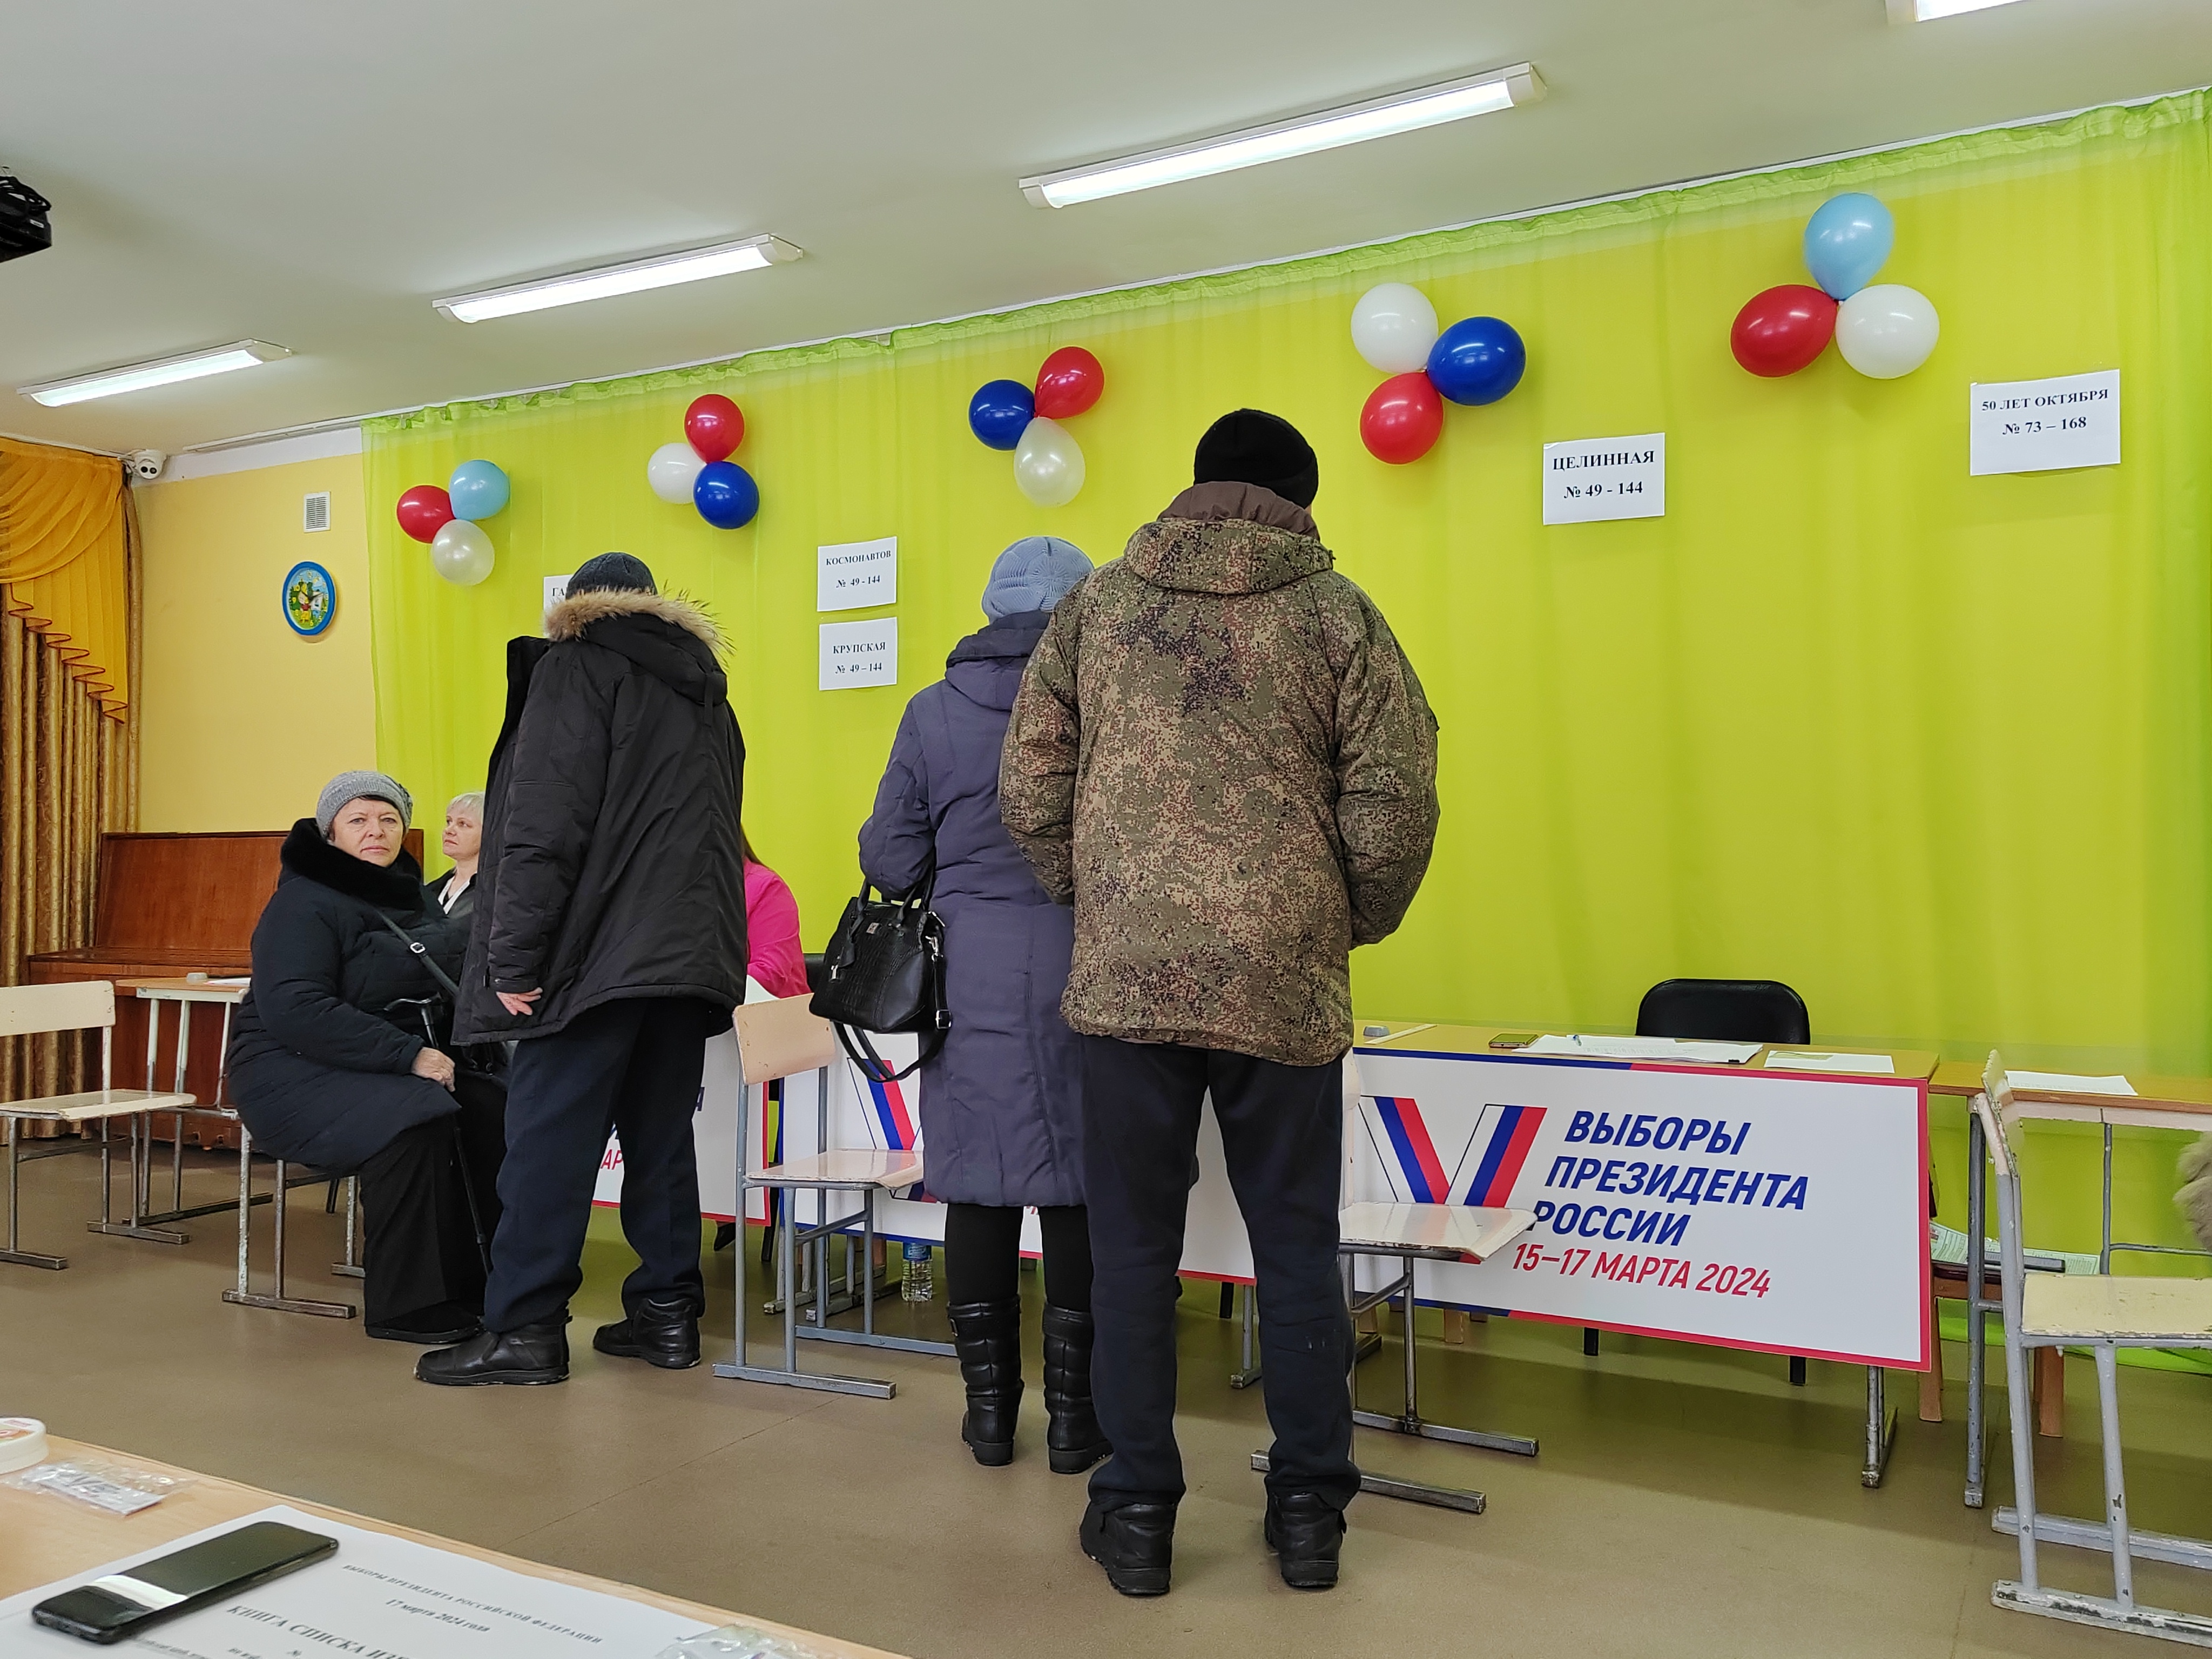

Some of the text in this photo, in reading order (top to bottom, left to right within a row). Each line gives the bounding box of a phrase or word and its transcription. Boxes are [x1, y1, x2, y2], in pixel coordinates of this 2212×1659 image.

[1982, 389, 2108, 411] 50 ЛЕТ ОКТЯБРЯ
[2002, 423, 2020, 434] №
[2025, 421, 2041, 433] 73
[2061, 416, 2087, 430] 168
[1553, 450, 1655, 471] ЦЕЛИННАЯ
[1564, 486, 1581, 498] №
[1585, 484, 1602, 496] 49
[1618, 481, 1643, 495] 144
[826, 550, 891, 565] КОСМОНАВТОВ
[836, 579, 846, 588] №
[851, 578, 860, 586] 49
[868, 575, 880, 584] 144
[833, 642, 886, 654] КРУПСКАЯ
[835, 665, 845, 674] №
[850, 664, 859, 672] 49
[869, 662, 882, 671] 144
[1564, 1110, 1751, 1155] ВЫБОРЫ
[1545, 1155, 1809, 1210] ПРЕЗИДЕНТА
[1526, 1201, 1691, 1246] РОССИИ
[1591, 1251, 1691, 1289] МАРТА
[1695, 1263, 1770, 1298] 2024
[401, 1604, 435, 1616] марта
[435, 1613, 466, 1624] 2024
[455, 1597, 532, 1621] РОССИЙСКОЙ
[532, 1620, 603, 1644] ФЕДЕРАЦИИ
[227, 1606, 289, 1628] КНИГА
[289, 1623, 367, 1654] СПИСКА
